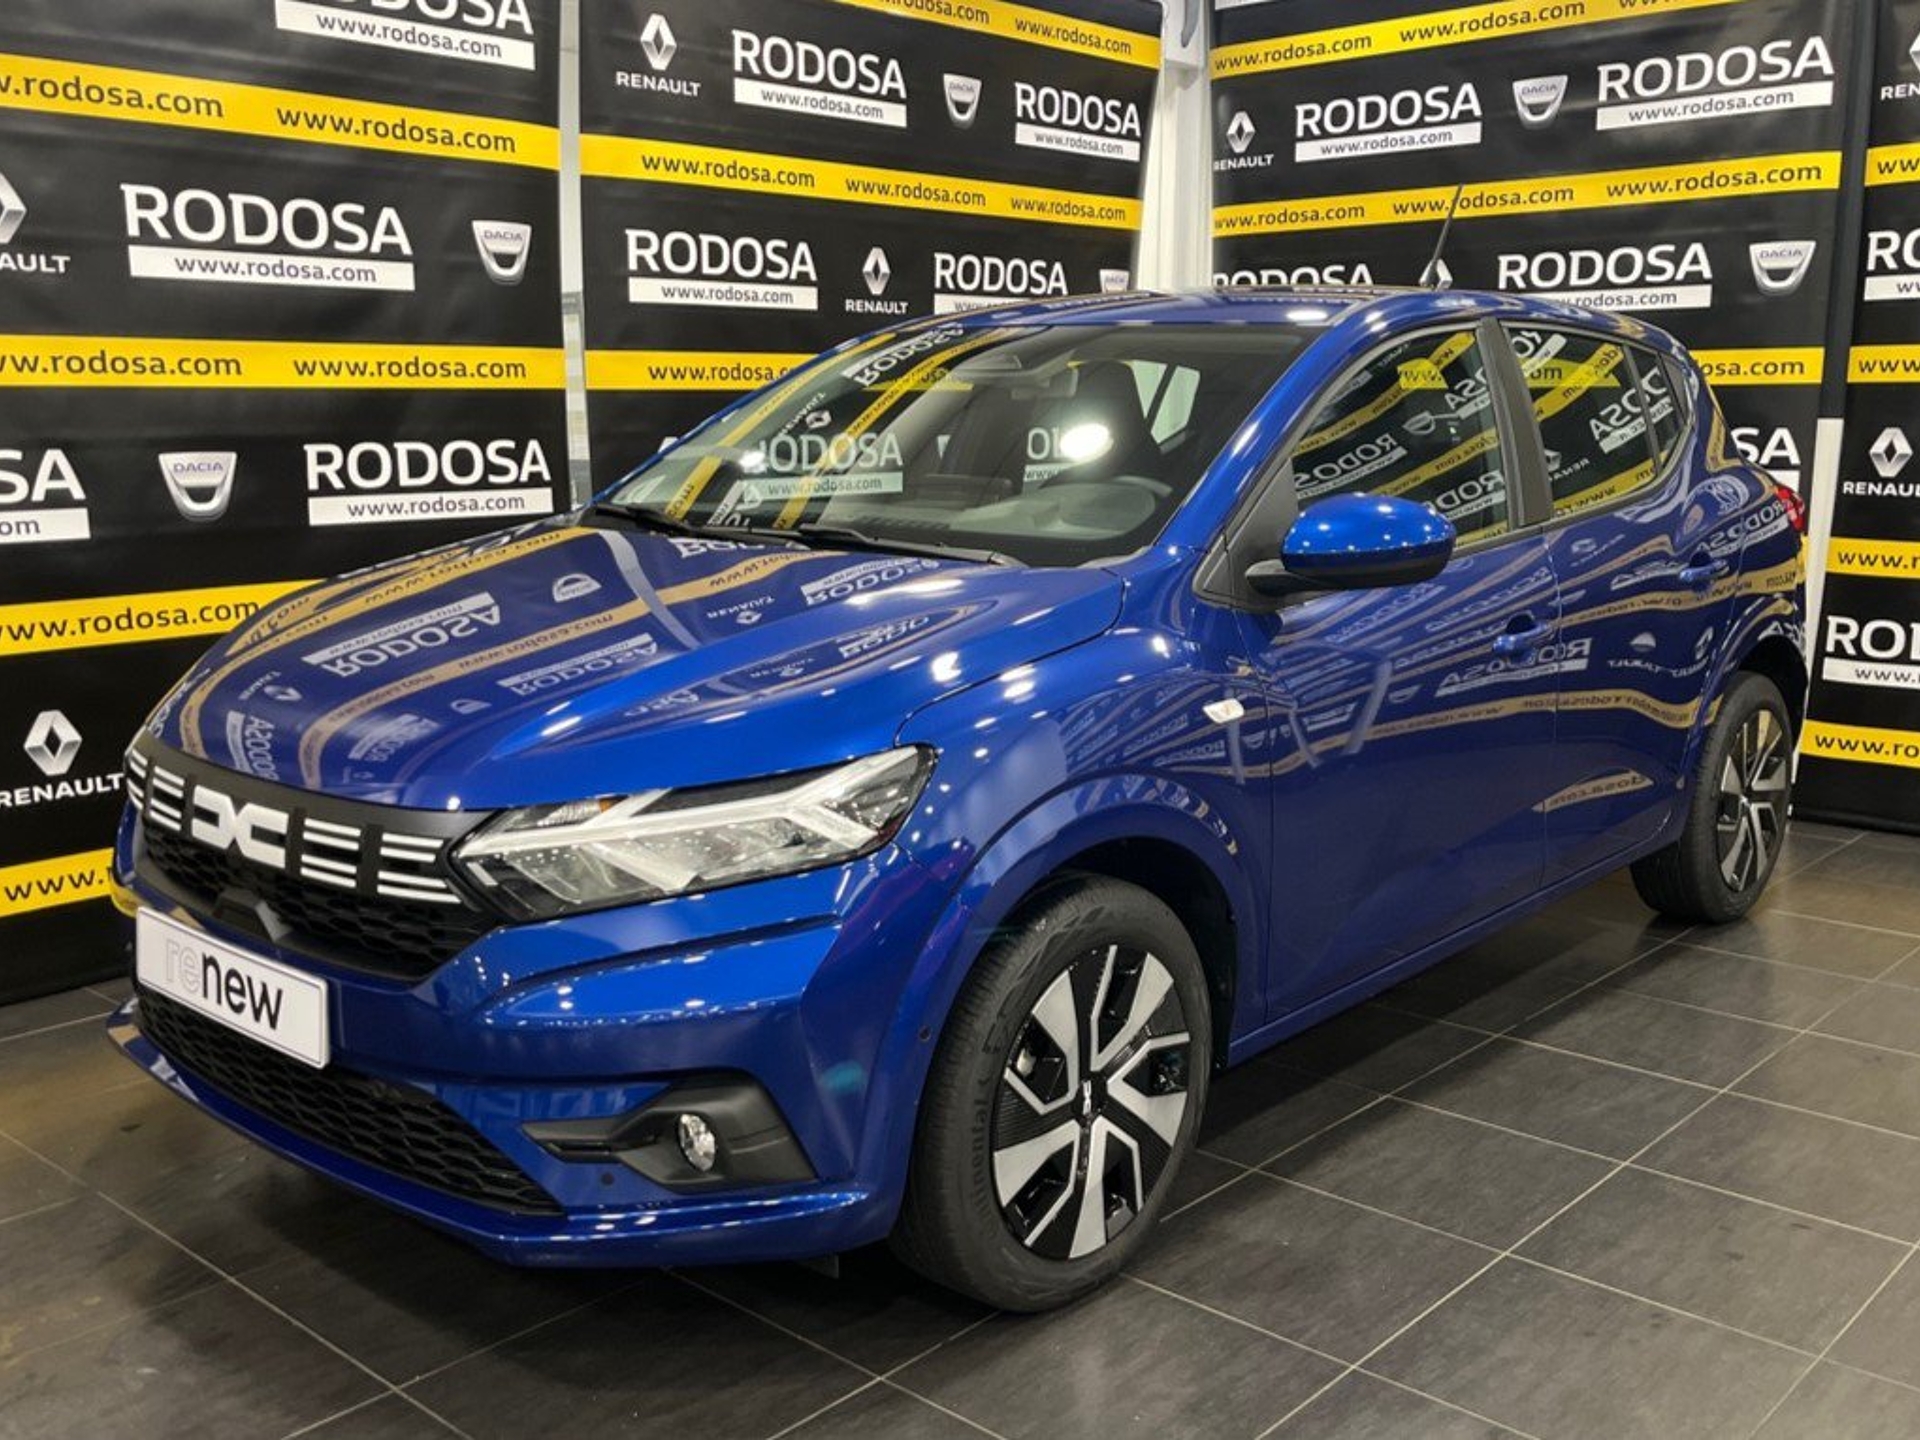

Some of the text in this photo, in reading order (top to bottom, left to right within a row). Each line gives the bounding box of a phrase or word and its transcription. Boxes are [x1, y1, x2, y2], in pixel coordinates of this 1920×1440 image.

[884, 0, 990, 24] .odosa.com
[1400, 2, 1585, 43] www.rodosa.com
[316, 14, 502, 57] www.rodosa.com
[1015, 17, 1132, 55] www.rodosa.com
[1214, 35, 1372, 71] www.rodosa.com
[731, 29, 907, 98] RODOSA
[1597, 35, 1834, 102] RODOSA
[615, 71, 700, 96] RENAULT
[761, 88, 884, 119] www.rodosa.com
[1015, 82, 1141, 137] RODOSA
[1296, 82, 1481, 138] RODOSA
[1629, 89, 1794, 122] www.rodosa.com
[277, 107, 515, 153] www.rodosa.com
[1034, 130, 1124, 155] www.rodosa.com
[1320, 128, 1453, 155] www.rodosa.com
[642, 153, 815, 188] www.rodosa.com
[1606, 162, 1822, 198] www.rodosa.com
[845, 175, 986, 207] www.rodosa.com
[1011, 195, 1125, 221] www.rodosa.com
[120, 183, 414, 257] RODOSA
[483, 229, 523, 243] DACIA
[175, 255, 376, 284] www.rodosa.com
[625, 229, 817, 281] RODOSA
[1498, 242, 1713, 289] RODOSA
[1759, 249, 1803, 260] DACIA
[934, 252, 1068, 296] RODOSA
[661, 285, 794, 304] www.rodosa.com
[845, 299, 908, 314] RENAULT
[0, 350, 242, 375] w.rodosa.com
[294, 355, 526, 379] www.rodosa.com
[173, 461, 223, 474] DACIA
[303, 439, 551, 491] RODOSA
[757, 433, 904, 475] ODOSA
[346, 494, 525, 517] www.rodosa.com
[0, 601, 260, 641] ww.rodosa.com
[1826, 615, 1920, 661] RO
[0, 773, 124, 807] RENAULT
[165, 938, 283, 1030] renew
